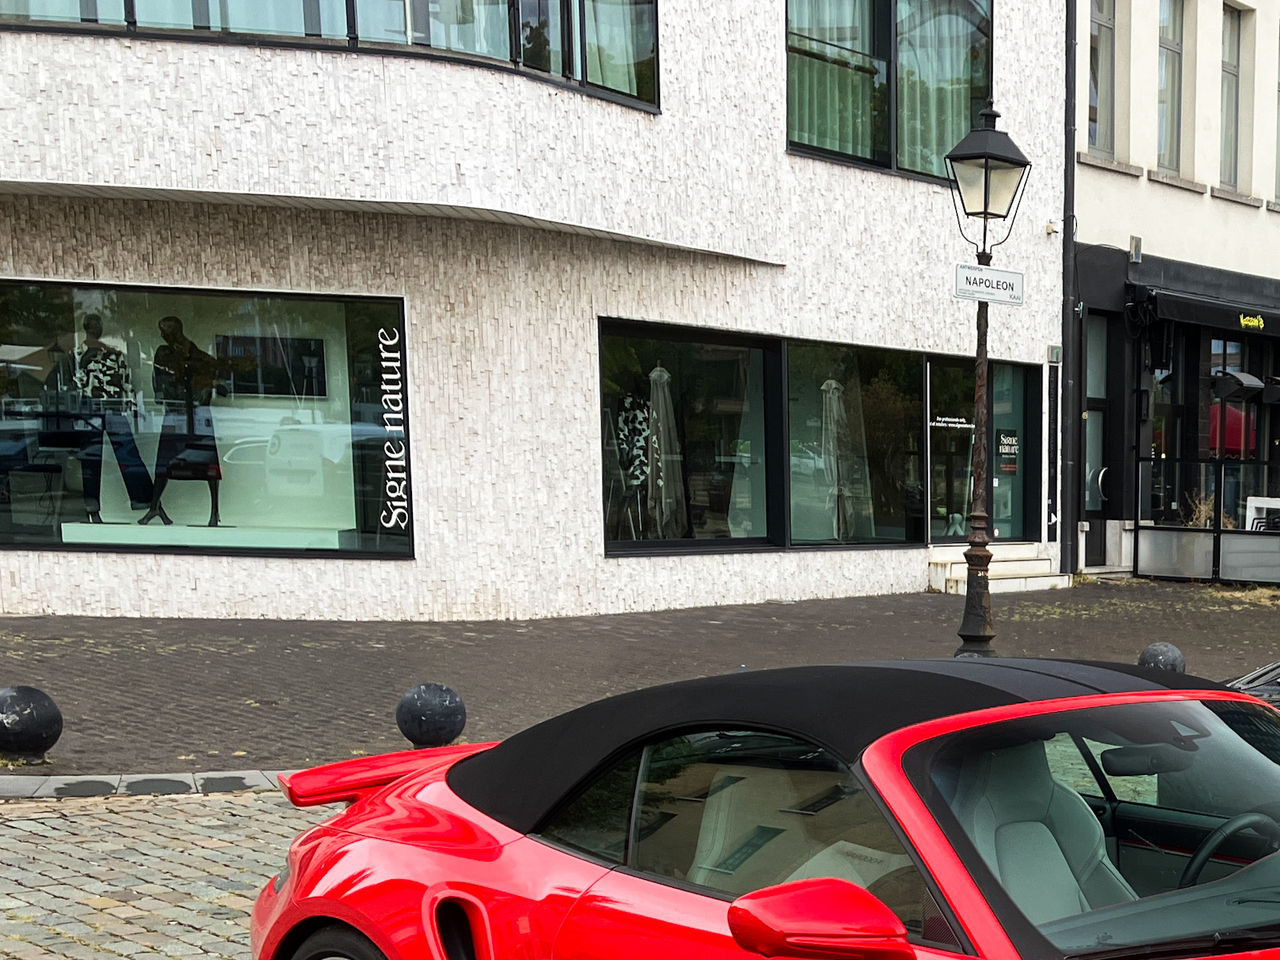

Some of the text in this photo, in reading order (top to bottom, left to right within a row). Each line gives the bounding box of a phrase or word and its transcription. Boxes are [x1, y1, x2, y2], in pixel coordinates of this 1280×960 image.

[965, 275, 1015, 292] NAPOLEON
[377, 327, 409, 530] Signe nature
